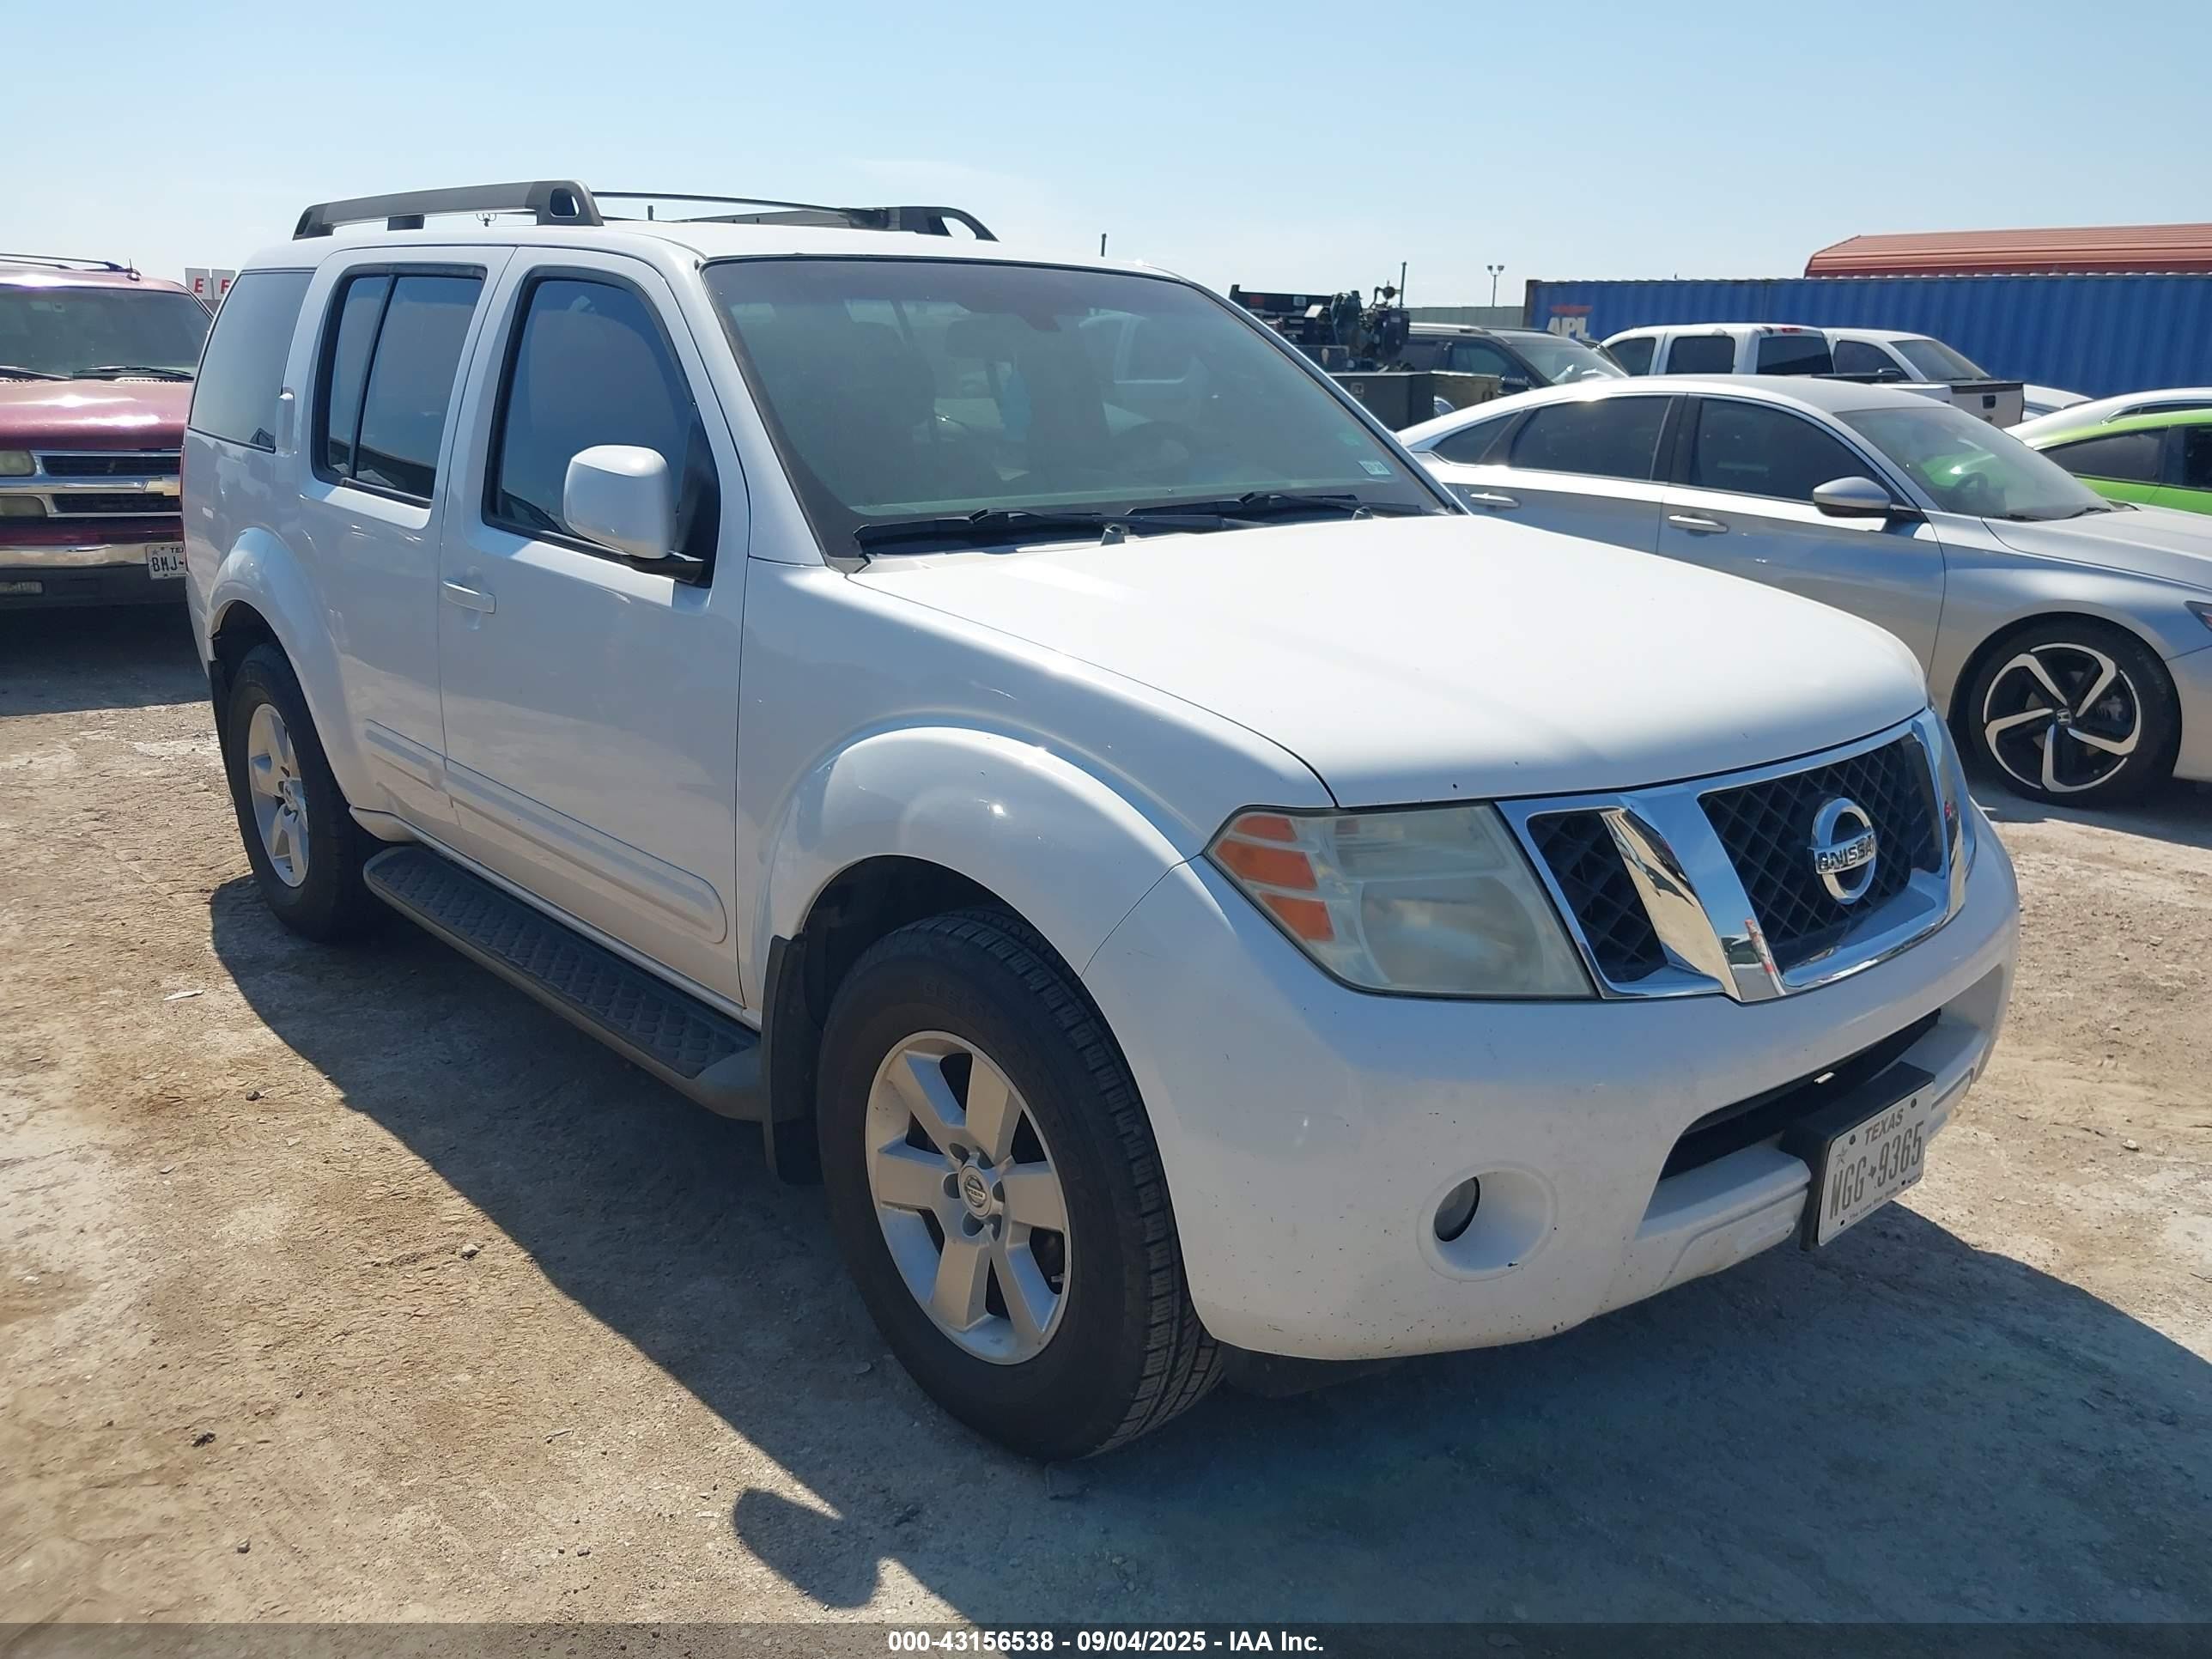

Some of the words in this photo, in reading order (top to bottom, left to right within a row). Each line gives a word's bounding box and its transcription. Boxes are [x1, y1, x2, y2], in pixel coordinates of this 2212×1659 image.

[193, 278, 204, 293] E
[1547, 317, 1590, 340] APL
[1864, 1108, 1904, 1146] TEXAS
[1876, 1120, 1924, 1188] 9365
